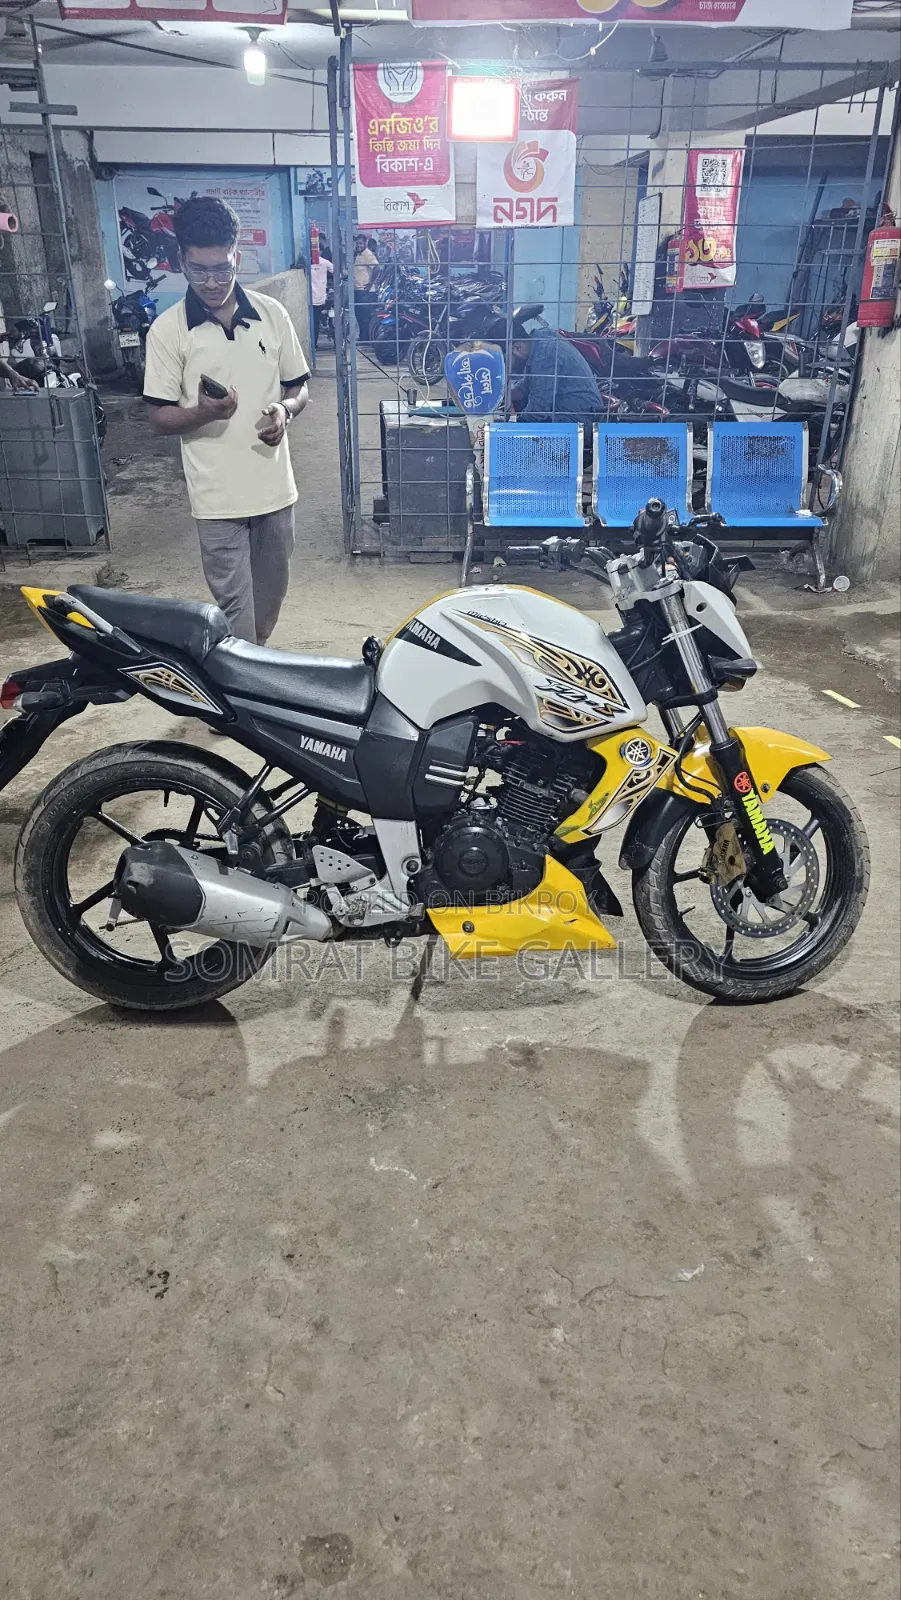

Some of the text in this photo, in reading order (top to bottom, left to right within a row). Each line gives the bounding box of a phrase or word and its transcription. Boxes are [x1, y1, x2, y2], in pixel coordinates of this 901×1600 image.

[534, 90, 568, 103] করুন
[397, 139, 419, 151] জমা
[423, 136, 441, 150] দিন
[375, 154, 434, 173] বিকাশ-এ
[493, 197, 558, 223] নগদ
[405, 619, 441, 650] AMAHA
[299, 735, 348, 763] YAMAHA
[741, 787, 776, 856] YAMAHA
